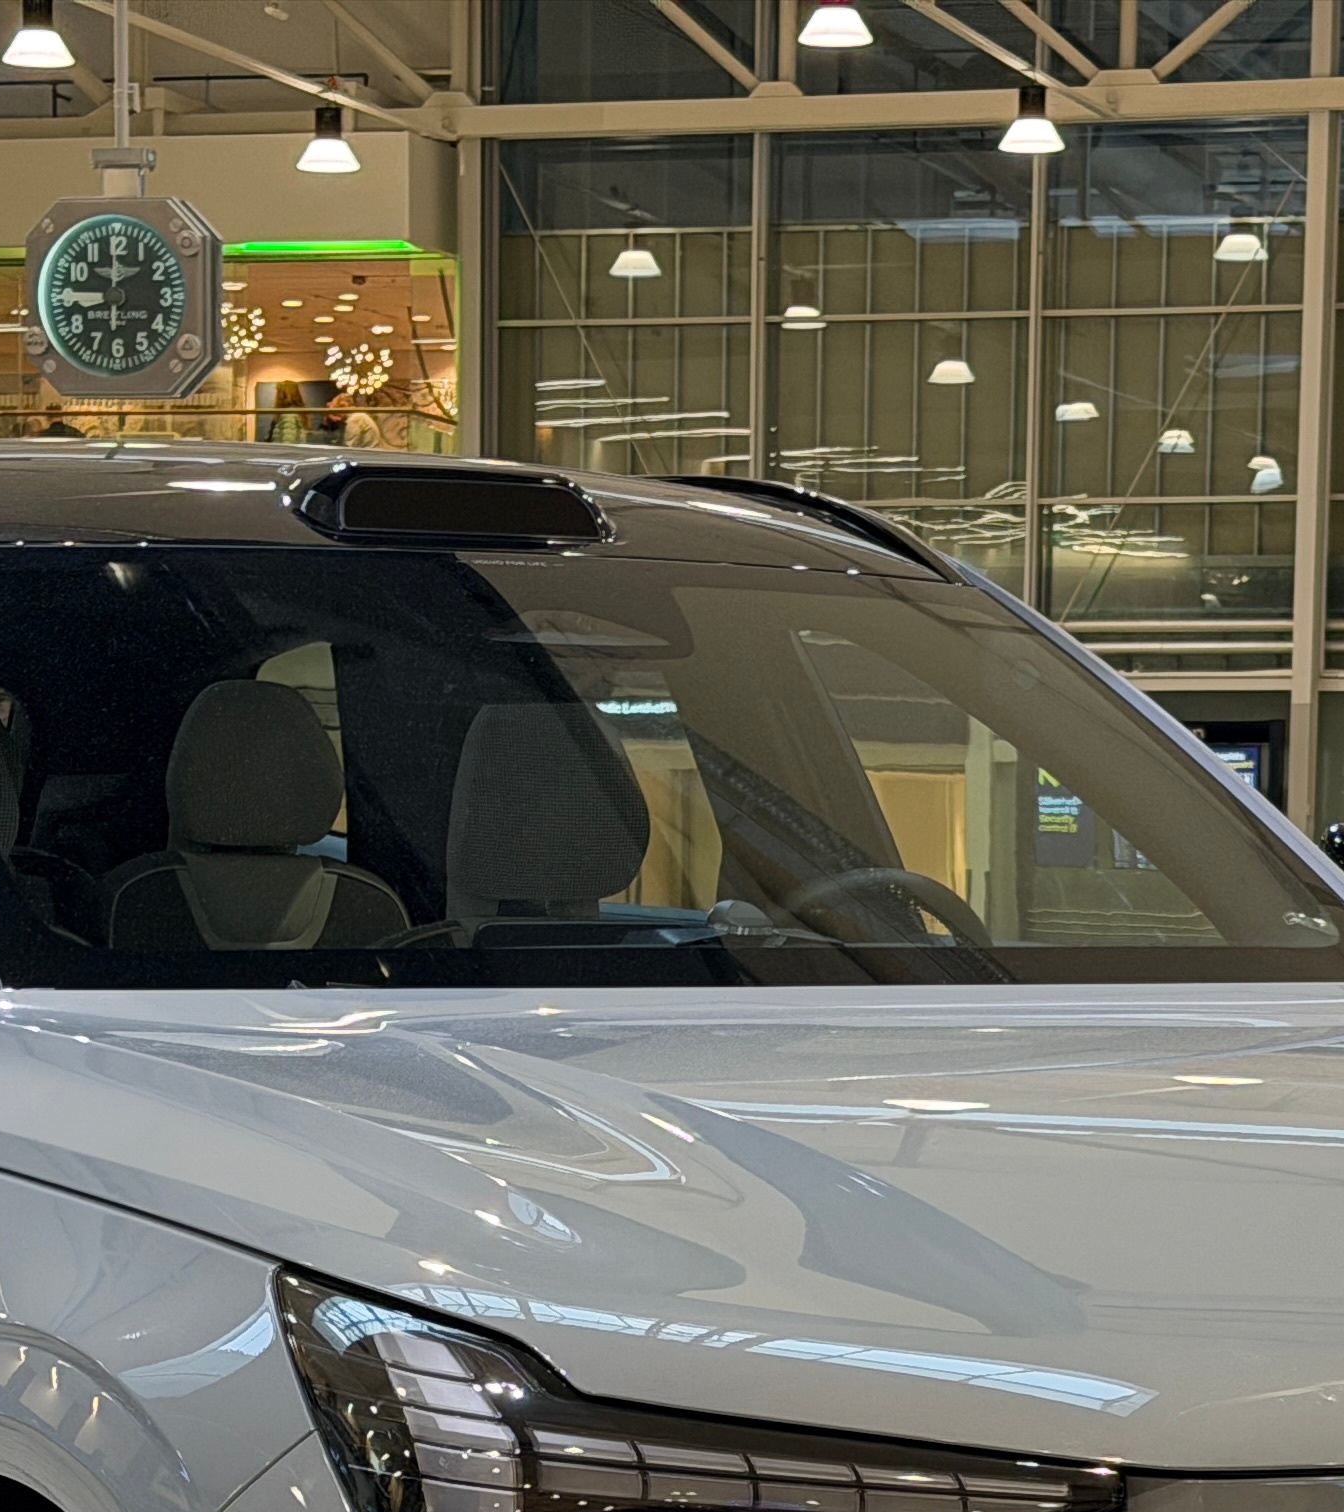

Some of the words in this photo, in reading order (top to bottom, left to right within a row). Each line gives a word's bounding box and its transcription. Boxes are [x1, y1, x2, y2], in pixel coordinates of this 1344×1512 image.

[87, 242, 99, 263] 11
[109, 236, 128, 256] 12
[70, 261, 88, 282] 10
[152, 261, 165, 281] 2
[159, 287, 173, 307] 3
[71, 314, 83, 334] 8
[87, 310, 148, 320] BRETLING
[151, 313, 164, 334] 4
[90, 331, 102, 351] 7
[111, 338, 124, 358] 6
[135, 331, 148, 351] 5
